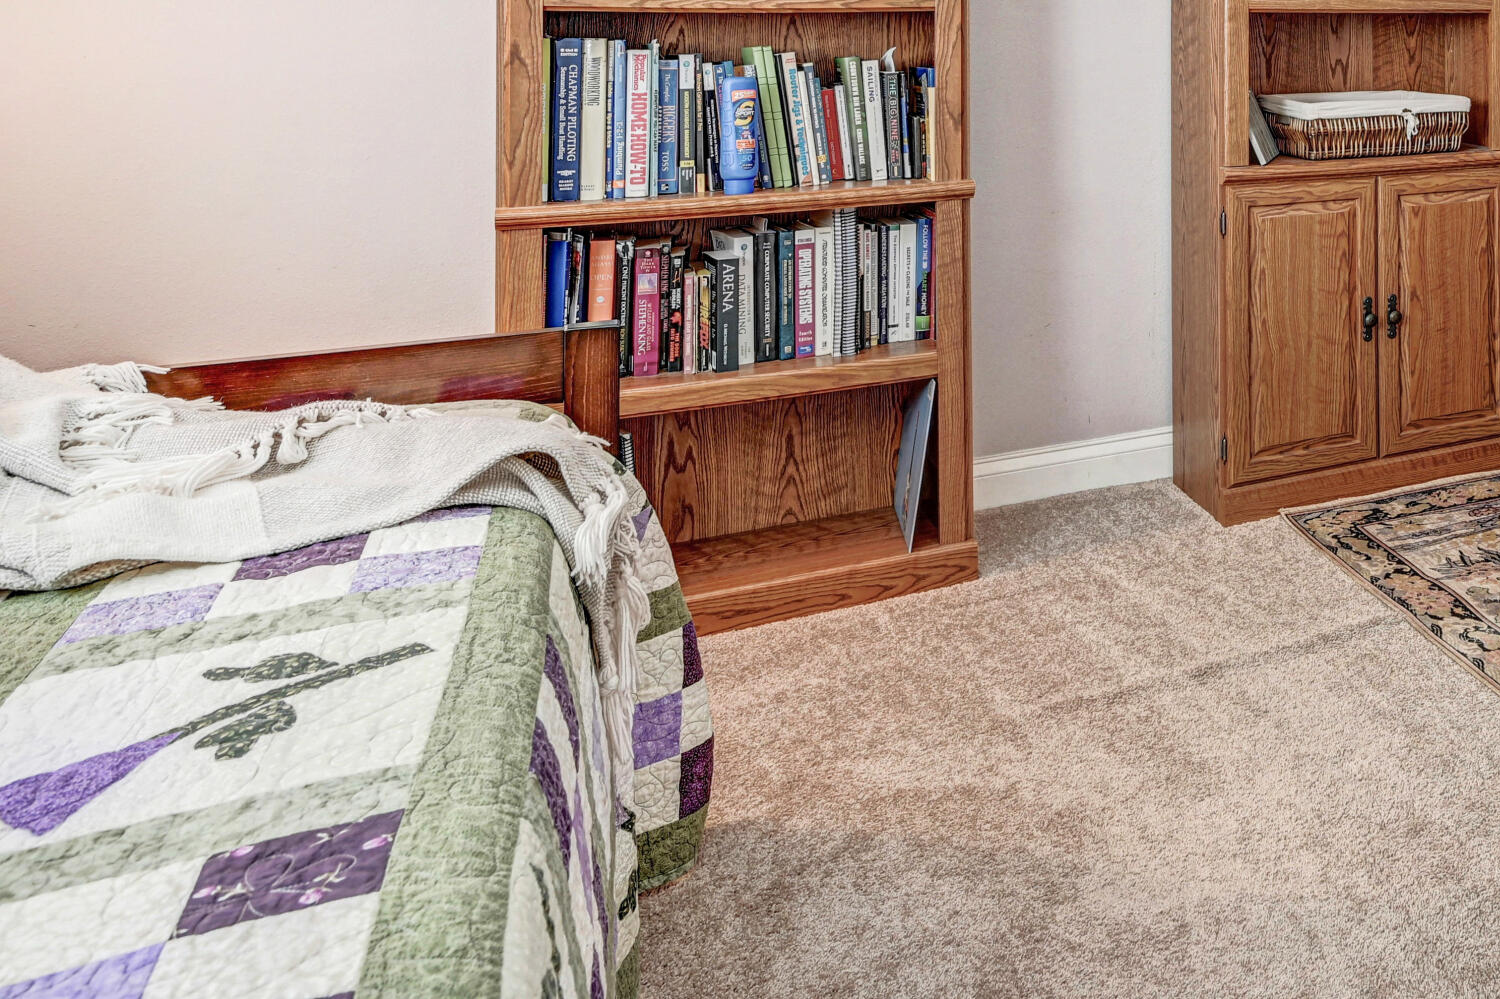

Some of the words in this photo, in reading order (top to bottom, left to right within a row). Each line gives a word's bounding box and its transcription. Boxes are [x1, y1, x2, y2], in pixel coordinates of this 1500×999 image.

[587, 57, 602, 107] WOODWORKING
[633, 54, 641, 91] Mechanics
[639, 54, 647, 82] Popular
[788, 68, 799, 98] Router
[848, 61, 859, 96] COUNTDOWN
[568, 64, 579, 114] CHAPMAN
[866, 66, 875, 103] SAILING
[889, 79, 897, 96] THE
[558, 105, 566, 121] Small
[630, 92, 648, 131] HOME
[790, 100, 803, 118] Jigs
[853, 96, 861, 106] BIN
[890, 99, 898, 116] BIG
[662, 105, 676, 143] RIGGER'S
[854, 107, 863, 126] LADEN
[890, 119, 899, 141] NINE
[556, 136, 566, 161] Handling
[566, 116, 577, 162] PILOTING
[855, 128, 864, 144] CHRIS
[614, 142, 625, 176] Plumbing
[630, 133, 647, 186] HOW-TO
[661, 151, 671, 172] TOSS
[795, 127, 811, 176] Techniques
[858, 145, 866, 166] WALLACE
[620, 266, 629, 280] ONE
[798, 248, 813, 290] OPERATING
[722, 263, 736, 313] ARENA
[739, 274, 747, 297] DATA
[619, 301, 628, 328] DOCTRINE
[638, 299, 647, 334] STEPHEN
[738, 298, 747, 335] MINING
[798, 290, 813, 324] SYSTEMS
[920, 292, 928, 316] MONEY
[699, 300, 711, 351] FIREFOX
[637, 334, 646, 356] KING
